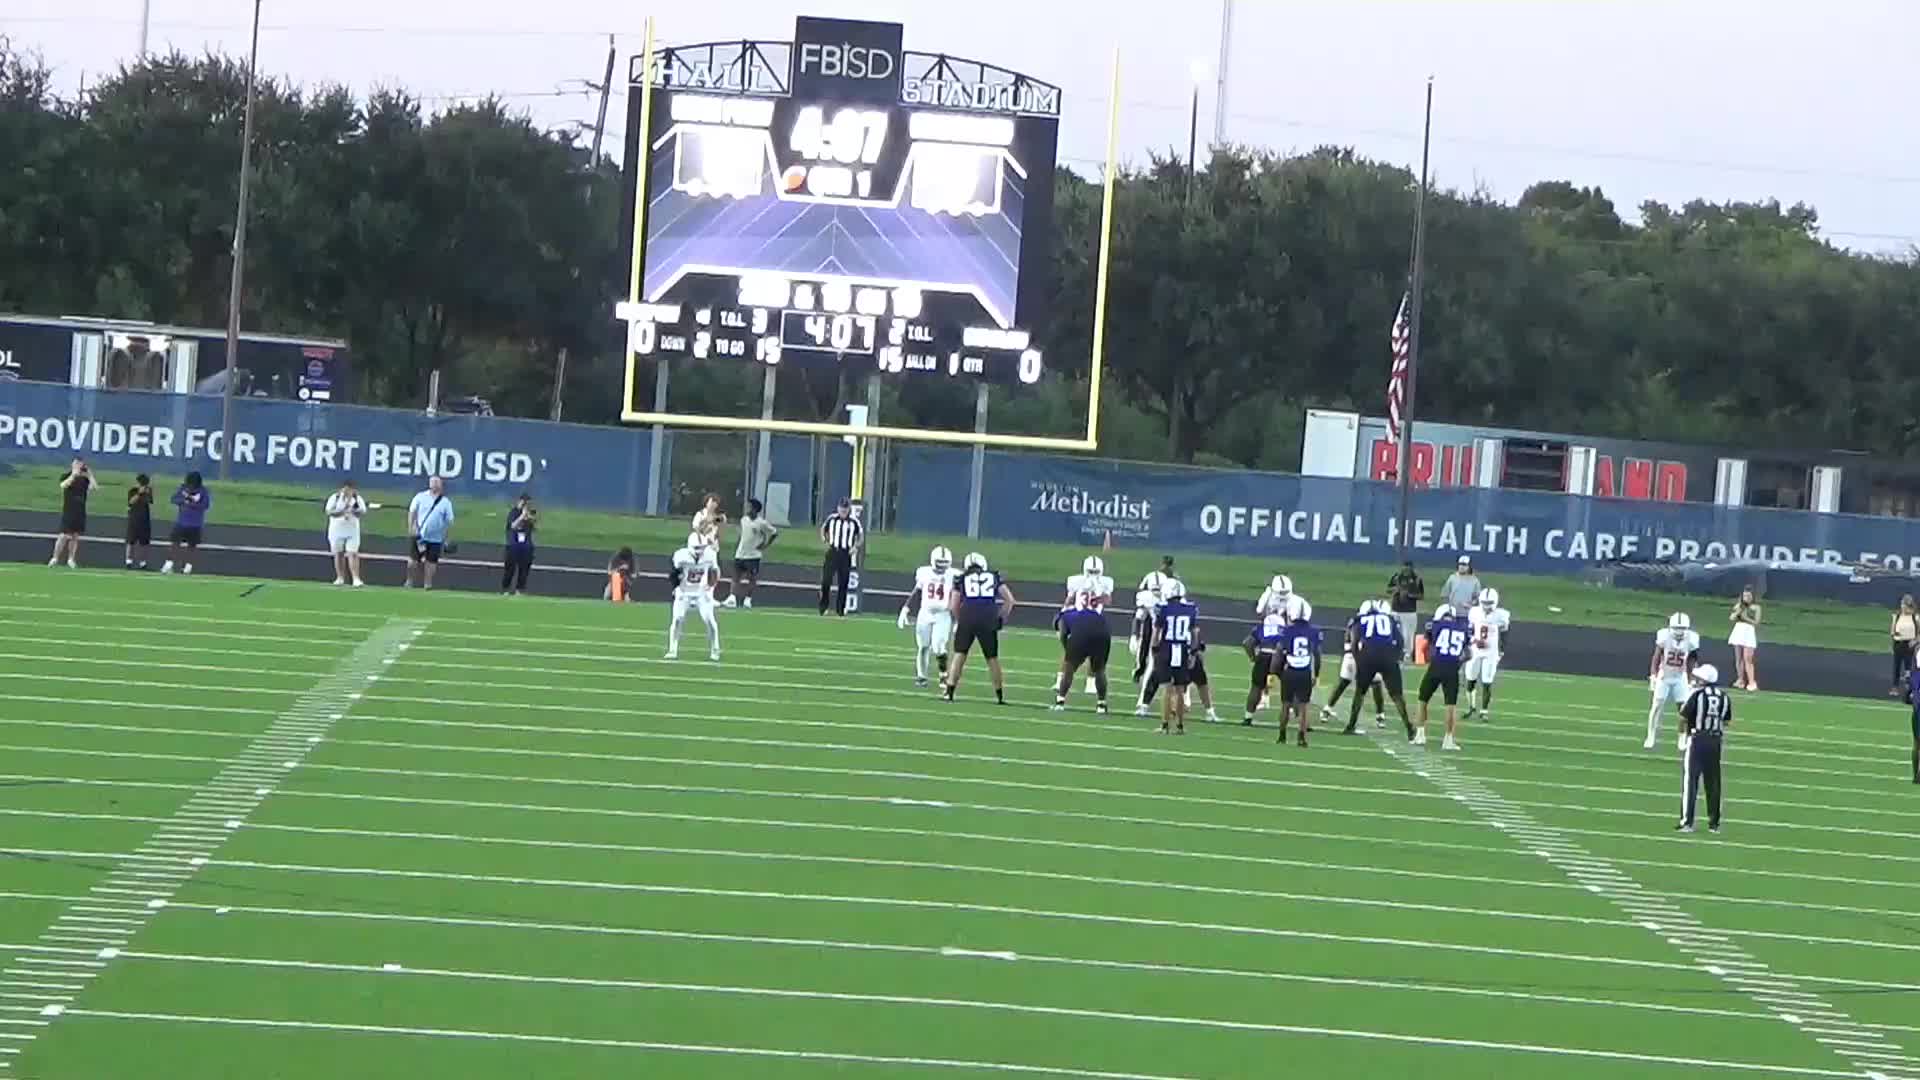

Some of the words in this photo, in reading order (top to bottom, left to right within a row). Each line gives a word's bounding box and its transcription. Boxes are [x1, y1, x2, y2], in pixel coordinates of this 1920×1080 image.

[800, 42, 893, 79] FBISD
[653, 57, 772, 92] HALL
[901, 77, 1059, 114] STADIUM
[790, 105, 888, 164] 4:07
[634, 320, 656, 354] 0
[804, 314, 876, 349] 4:07
[756, 336, 781, 364] 15
[1019, 349, 1042, 384] 0
[0, 414, 173, 457] PROVIDER
[185, 428, 256, 464] FOR
[266, 434, 359, 471] FORT
[368, 443, 462, 478] BEND
[474, 450, 533, 483] ISD
[1030, 491, 1152, 519] Methodist
[1199, 504, 1371, 545] OFFICIAL
[1387, 517, 1529, 556] HEALTH
[927, 582, 945, 600] 94
[963, 571, 995, 598] 62
[1165, 615, 1191, 641] 10
[1359, 614, 1392, 639] 70
[1292, 636, 1309, 657] 6
[1435, 627, 1466, 657] 45
[1666, 651, 1686, 668] 25
[1707, 695, 1720, 716] R
